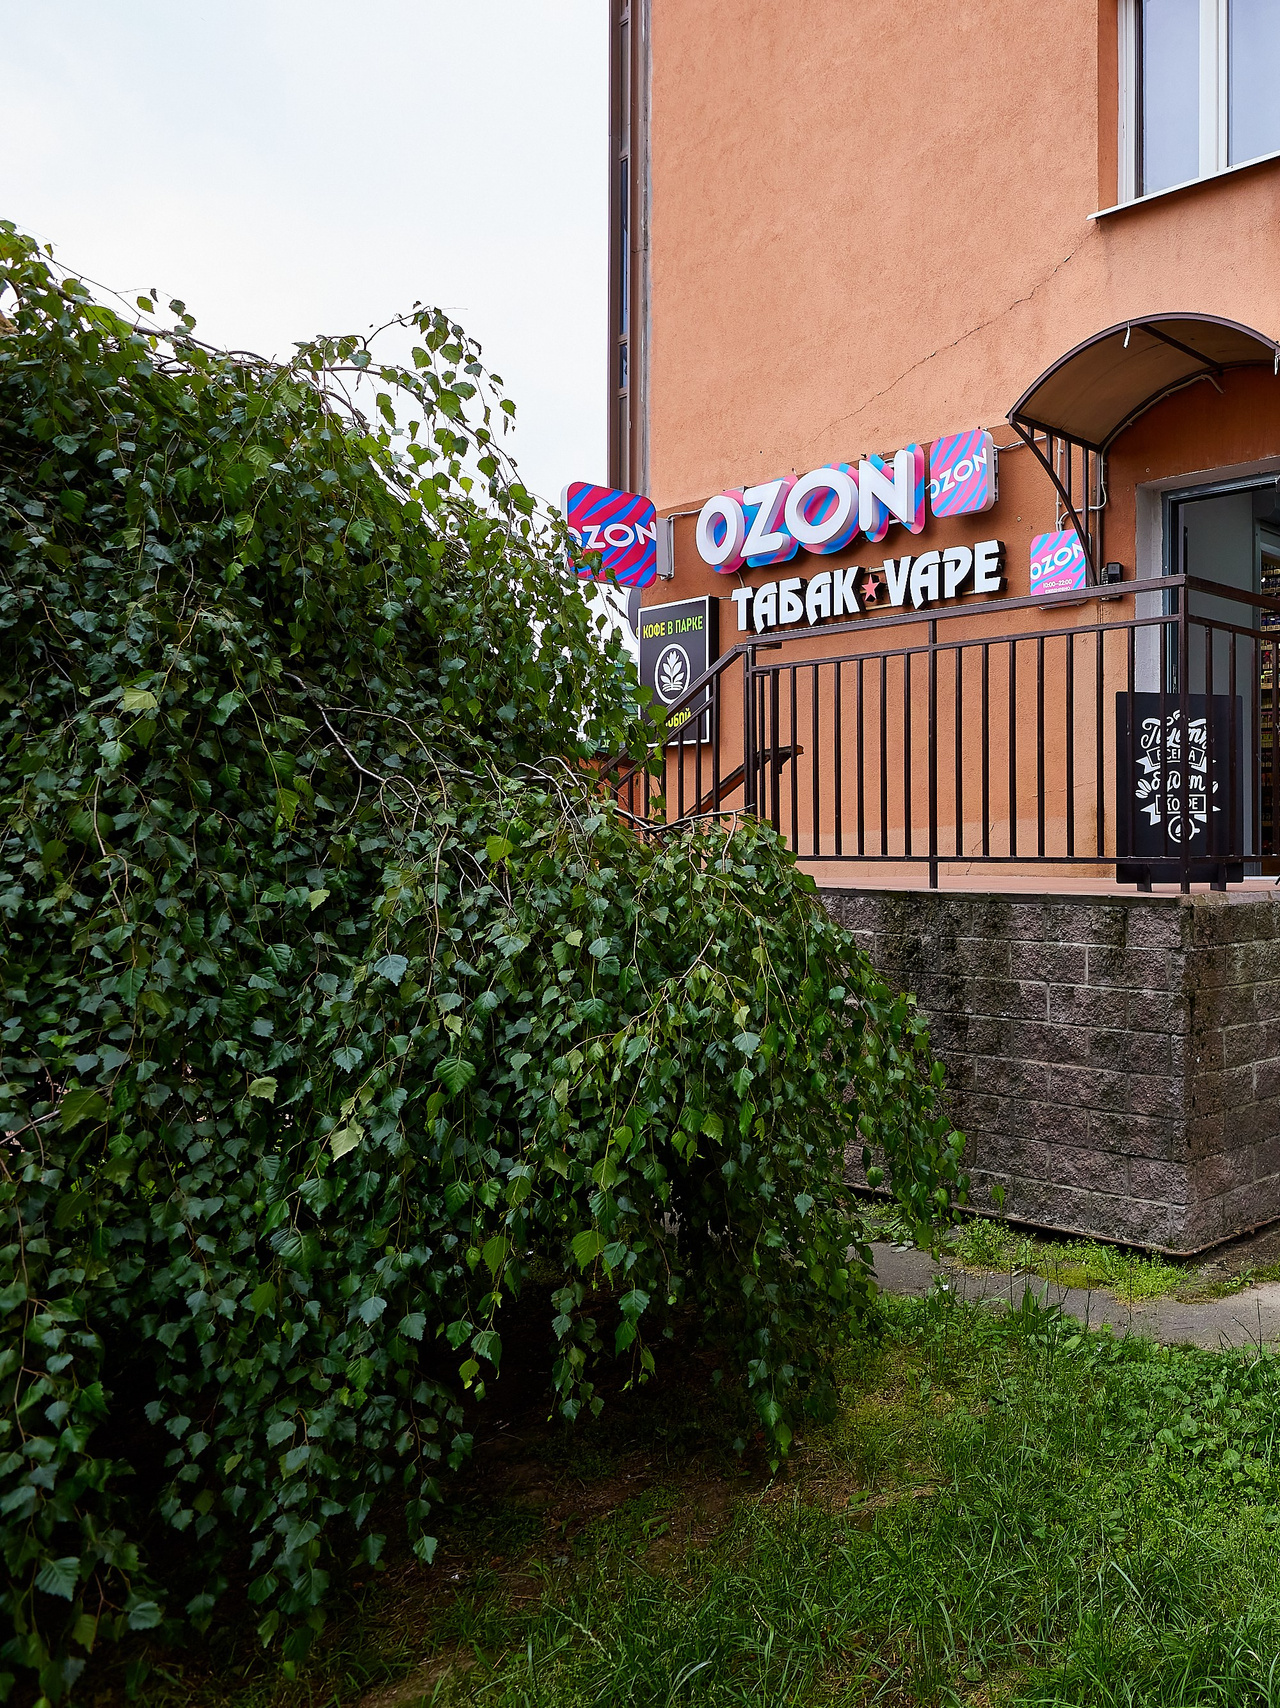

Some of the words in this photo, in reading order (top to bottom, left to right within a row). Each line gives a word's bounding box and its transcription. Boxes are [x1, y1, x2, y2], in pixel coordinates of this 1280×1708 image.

[695, 449, 915, 566] OZON
[731, 566, 863, 634] ТАБАК
[883, 539, 1003, 610] VAPE
[642, 622, 666, 639] КОФЕ
[667, 619, 673, 635] В
[675, 615, 704, 634] ПАРКЕ
[665, 707, 691, 728] ОБОЙ
